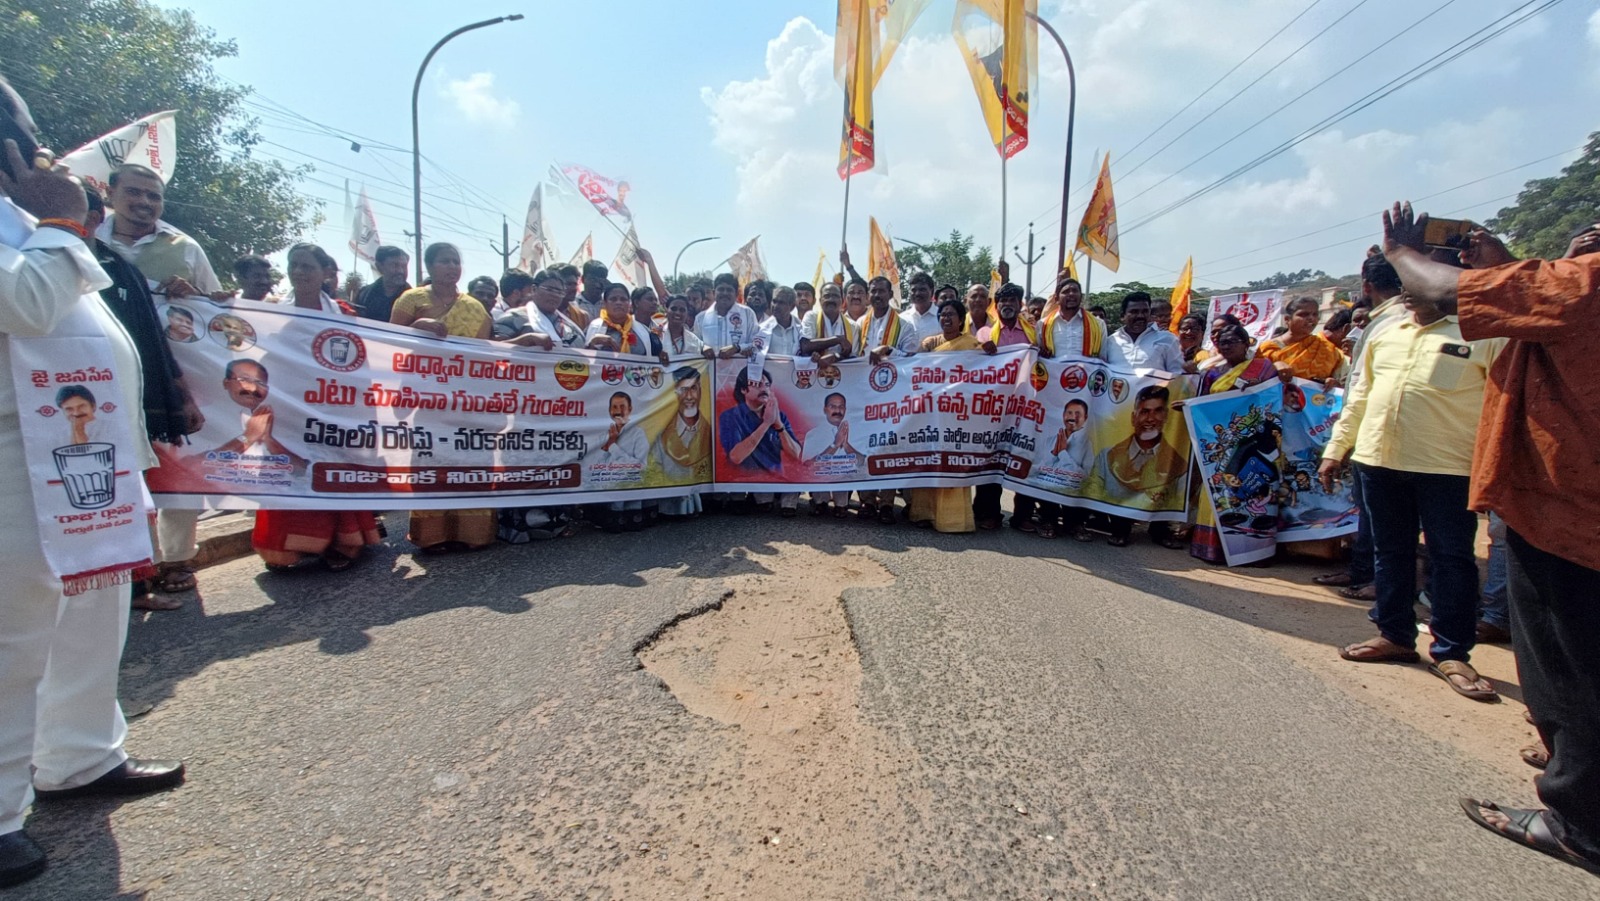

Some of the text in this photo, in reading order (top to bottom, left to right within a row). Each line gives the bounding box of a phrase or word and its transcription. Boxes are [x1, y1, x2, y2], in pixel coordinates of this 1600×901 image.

[55, 366, 114, 383] జనసేన
[392, 352, 465, 384] అధ్వాన
[468, 358, 536, 383] దారులు
[949, 358, 1021, 385] పాలనలో
[304, 377, 357, 406] ఎటు
[363, 383, 448, 410] చూసినా
[451, 388, 520, 415] గుంతలే
[937, 391, 969, 421] ఉన్న
[971, 389, 1005, 423] రోడ్ల
[303, 418, 379, 449] ఏపిలో
[381, 420, 433, 458] రోడ్లు
[454, 427, 536, 451] నరకానికి
[908, 425, 939, 444] జనసేన
[875, 453, 942, 469] గాజువాక
[325, 468, 437, 485] గాజువాక
